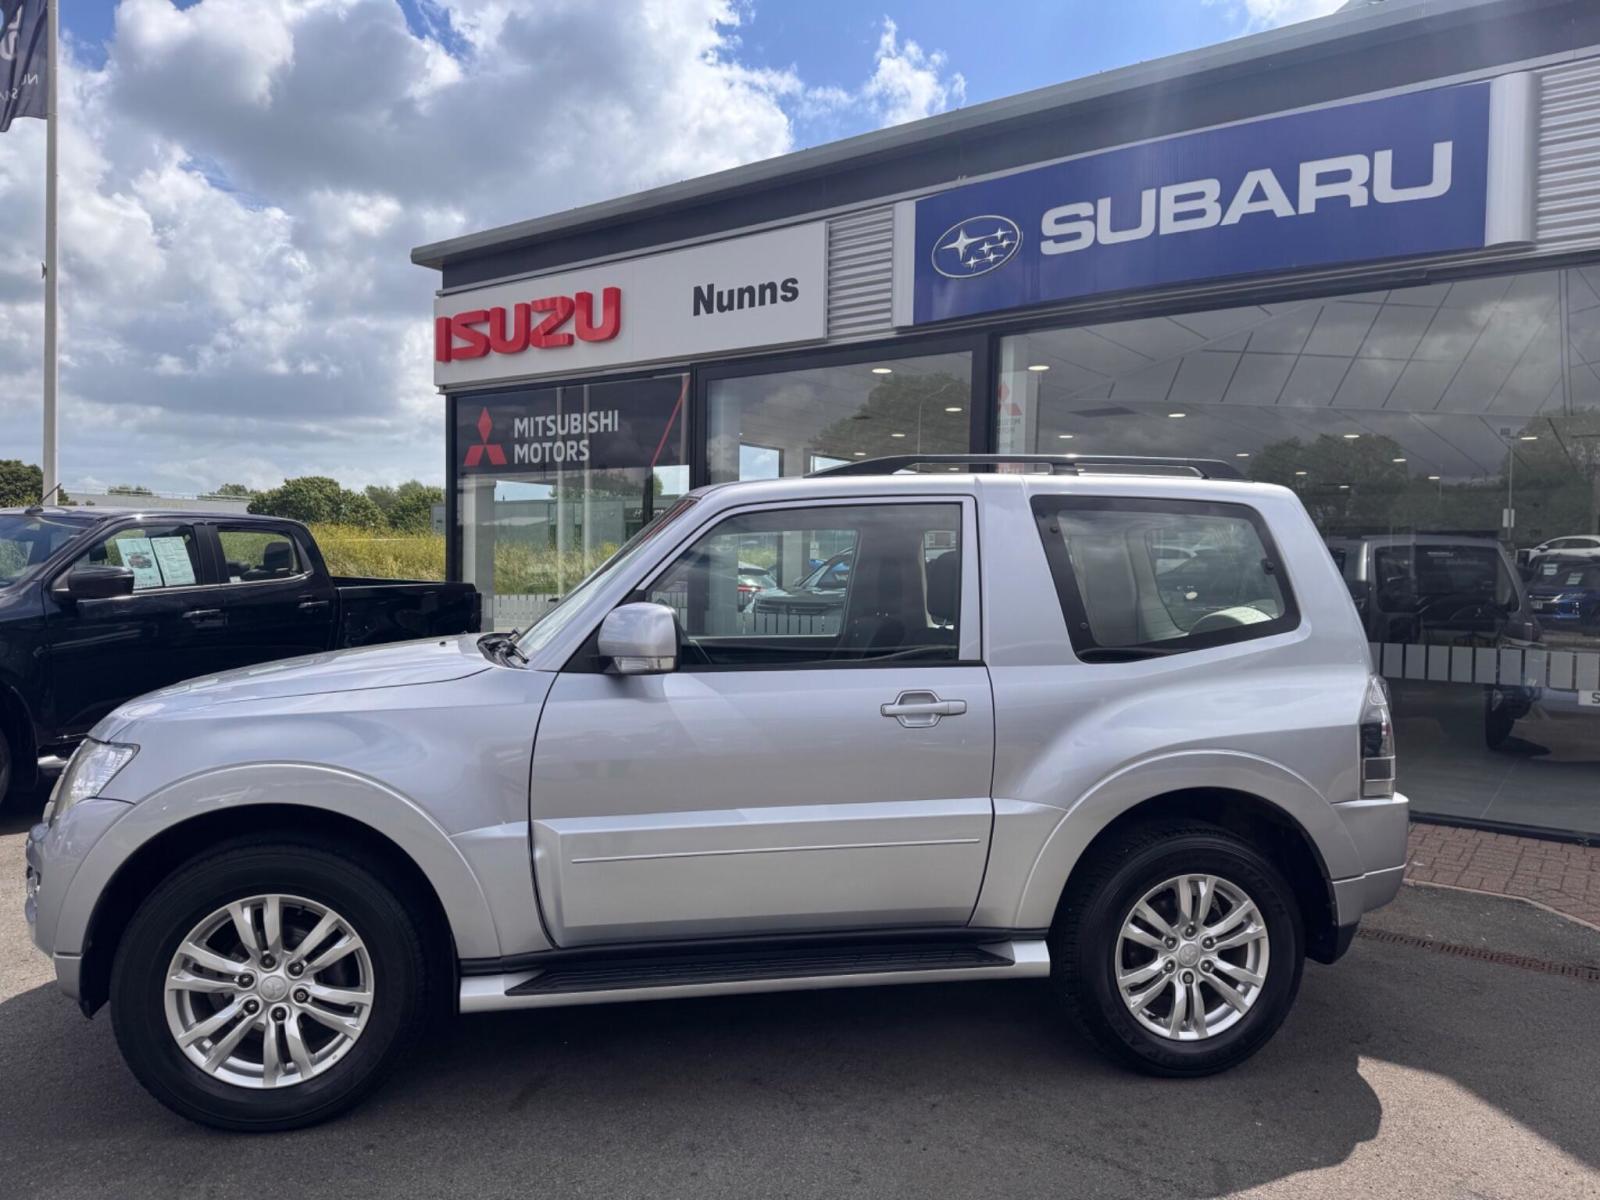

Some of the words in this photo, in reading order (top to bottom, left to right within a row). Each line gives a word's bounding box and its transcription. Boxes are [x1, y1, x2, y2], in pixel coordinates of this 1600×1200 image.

[1040, 141, 1453, 255] SUBARU
[693, 276, 799, 316] Nunns
[436, 287, 621, 362] ISUZU
[514, 409, 619, 438] MITSUBISHI
[514, 440, 590, 464] MOTORS
